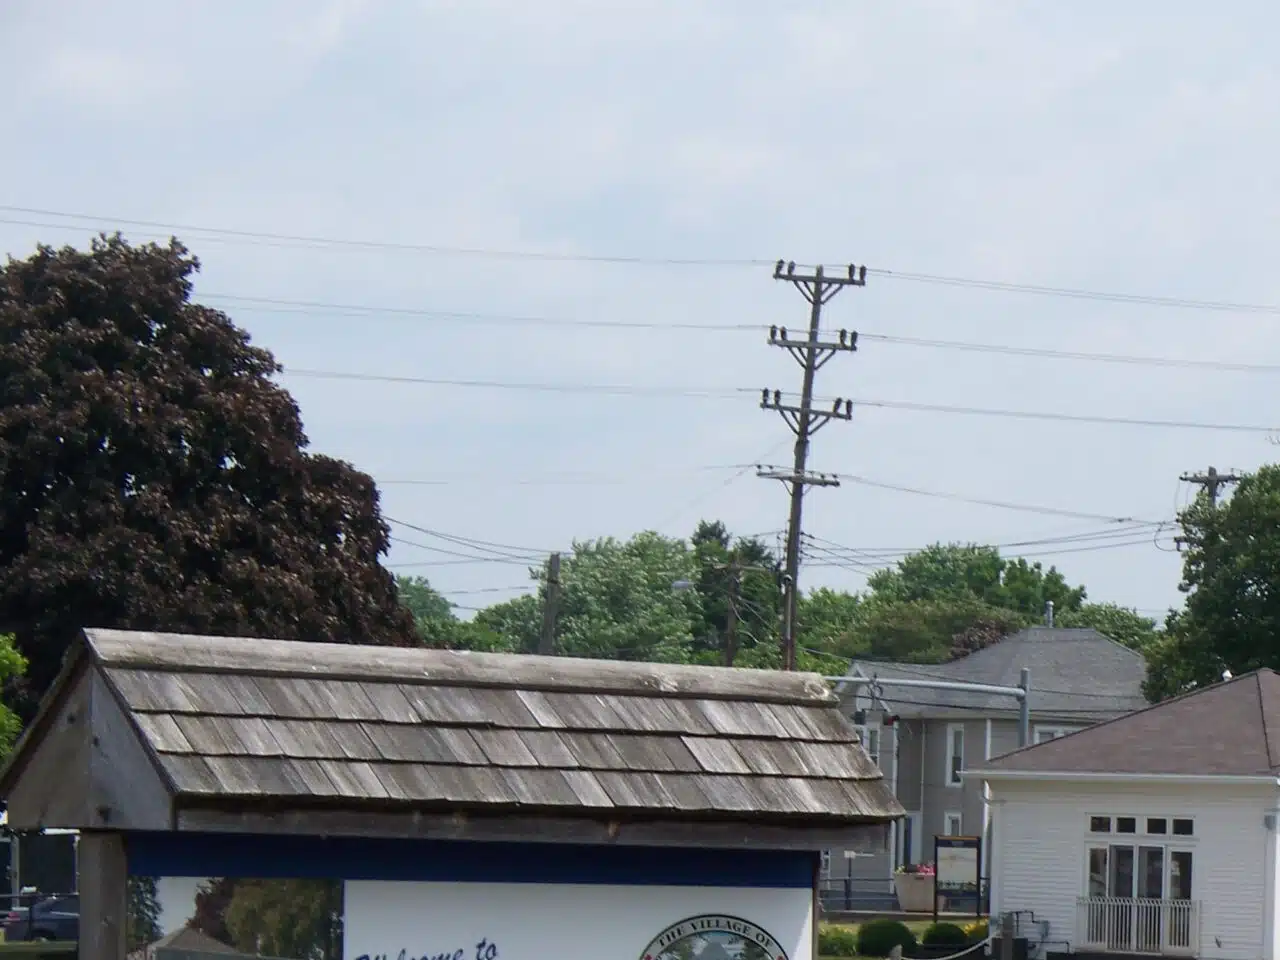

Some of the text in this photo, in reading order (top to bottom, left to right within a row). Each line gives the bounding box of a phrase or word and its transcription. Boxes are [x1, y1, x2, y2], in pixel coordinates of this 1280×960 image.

[657, 919, 775, 948] THE VILLAGE OF
